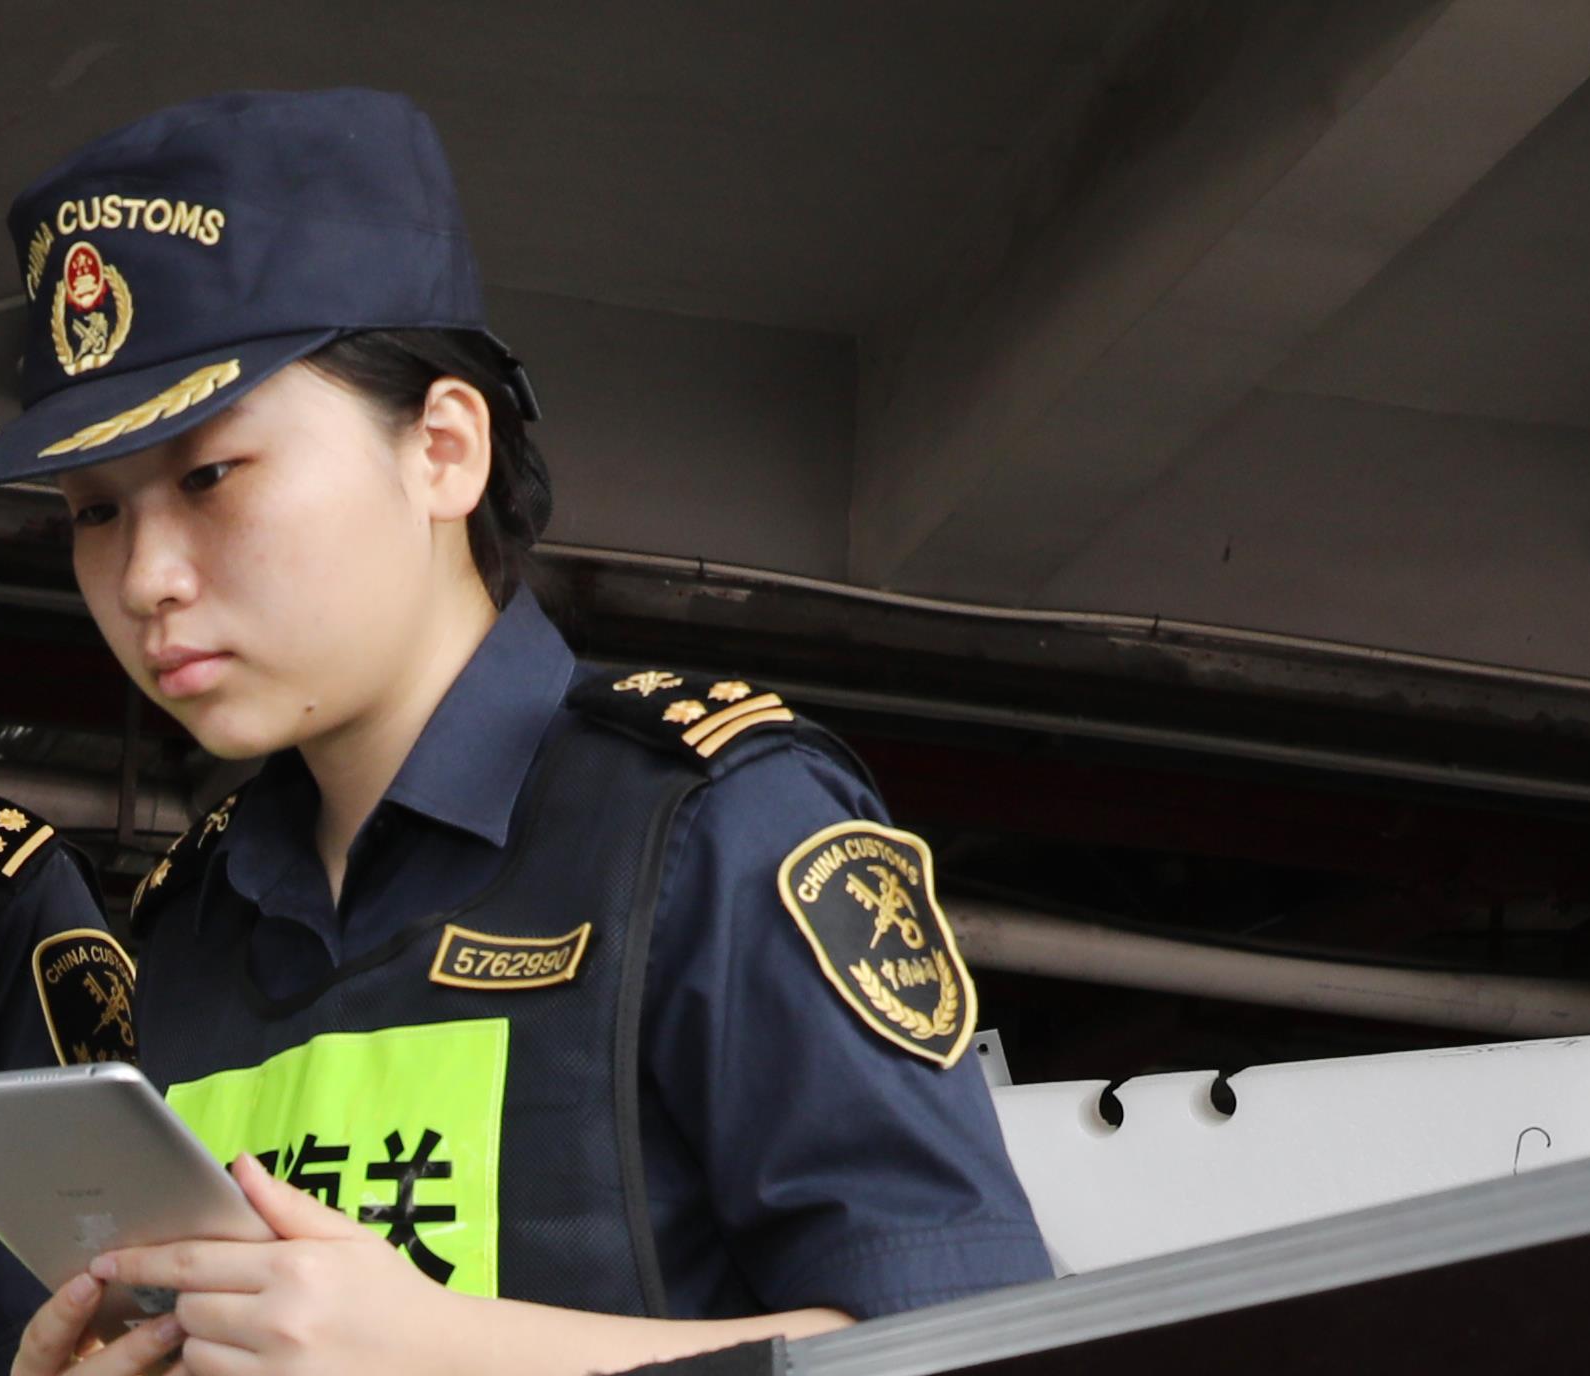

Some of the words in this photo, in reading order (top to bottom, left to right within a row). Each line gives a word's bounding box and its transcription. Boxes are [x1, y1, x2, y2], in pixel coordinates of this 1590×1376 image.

[56, 194, 225, 246] CUSTOMS
[797, 844, 848, 903] CHINA
[844, 837, 920, 886] CUSTOMS
[46, 945, 90, 984] CHINA
[453, 946, 570, 977] 5762990
